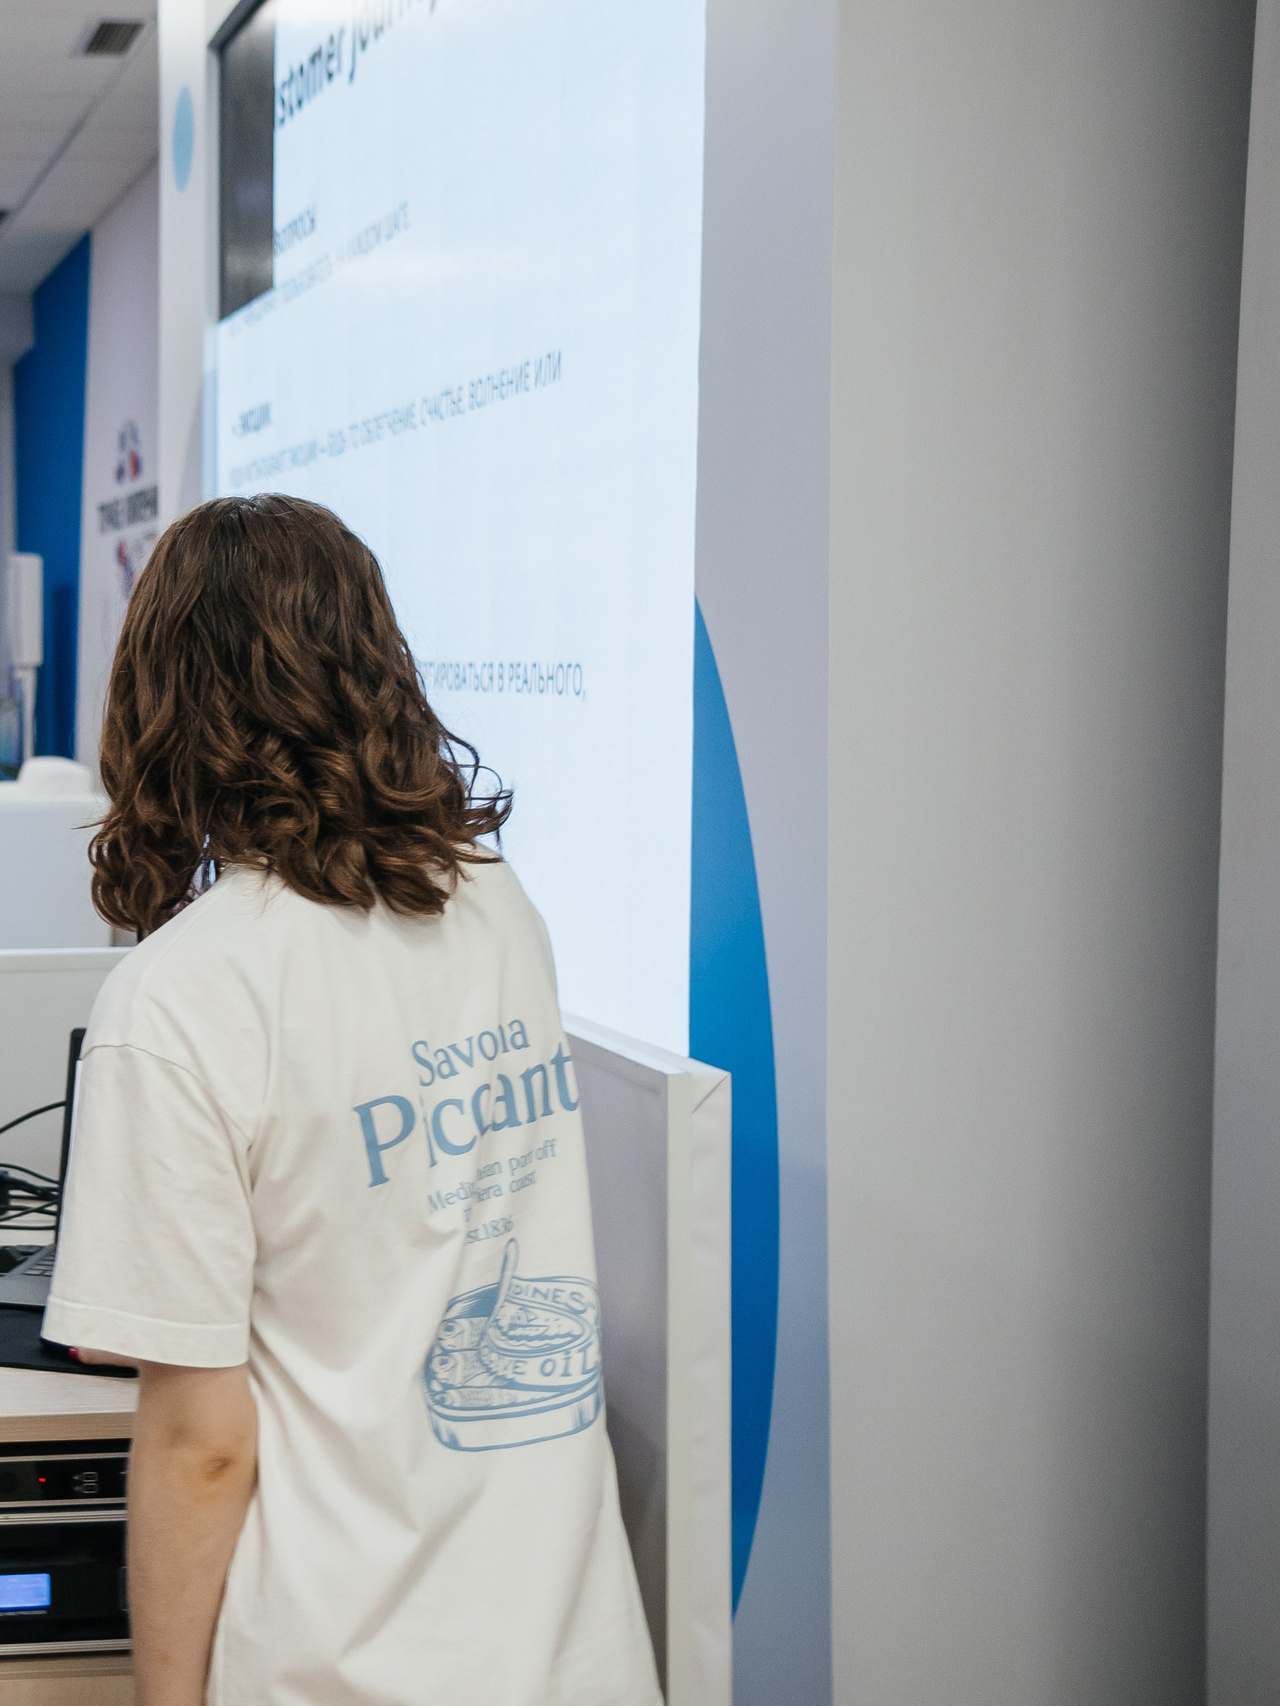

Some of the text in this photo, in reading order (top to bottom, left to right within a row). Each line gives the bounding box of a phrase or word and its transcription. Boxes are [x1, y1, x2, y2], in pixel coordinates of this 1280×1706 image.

[533, 350, 562, 388] ИЛИ
[497, 662, 505, 693] В
[411, 1018, 531, 1087] Savoia
